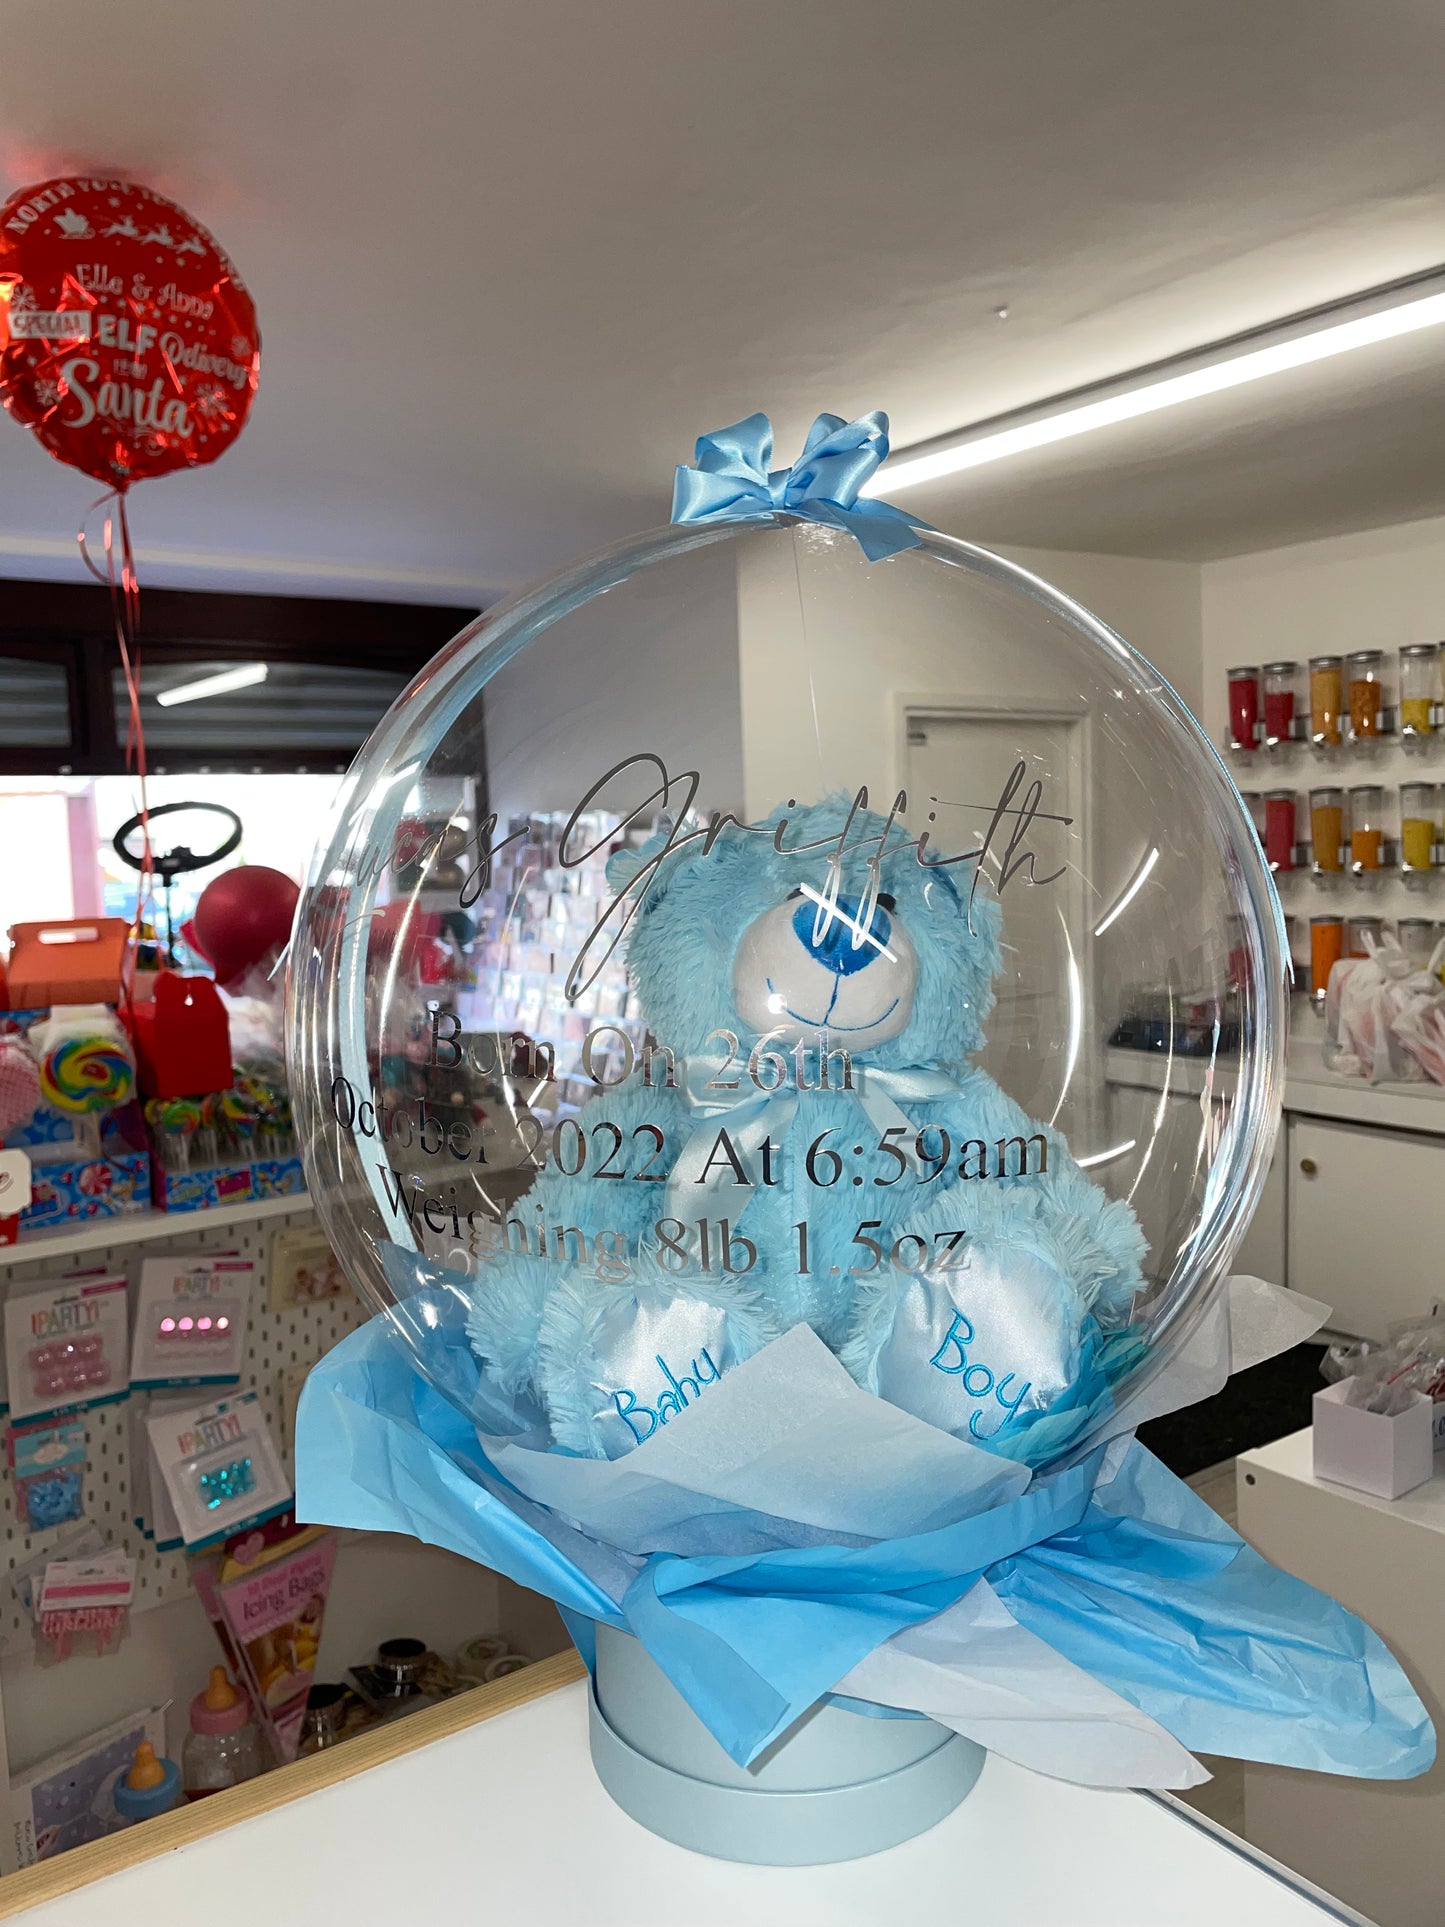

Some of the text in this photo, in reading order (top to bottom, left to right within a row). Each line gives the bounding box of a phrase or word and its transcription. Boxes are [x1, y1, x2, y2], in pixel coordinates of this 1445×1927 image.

[5, 182, 75, 235] NORTH
[131, 272, 153, 301] &
[13, 314, 85, 336] SPECIAL
[98, 313, 158, 355] ELF
[61, 358, 194, 438] Santa
[427, 1009, 856, 1091] Born On 26th
[331, 1076, 1048, 1187] October 2022 At 6:59am
[376, 1163, 968, 1284] Weighing 8lb 1.5oz
[929, 1307, 1031, 1441] Boy
